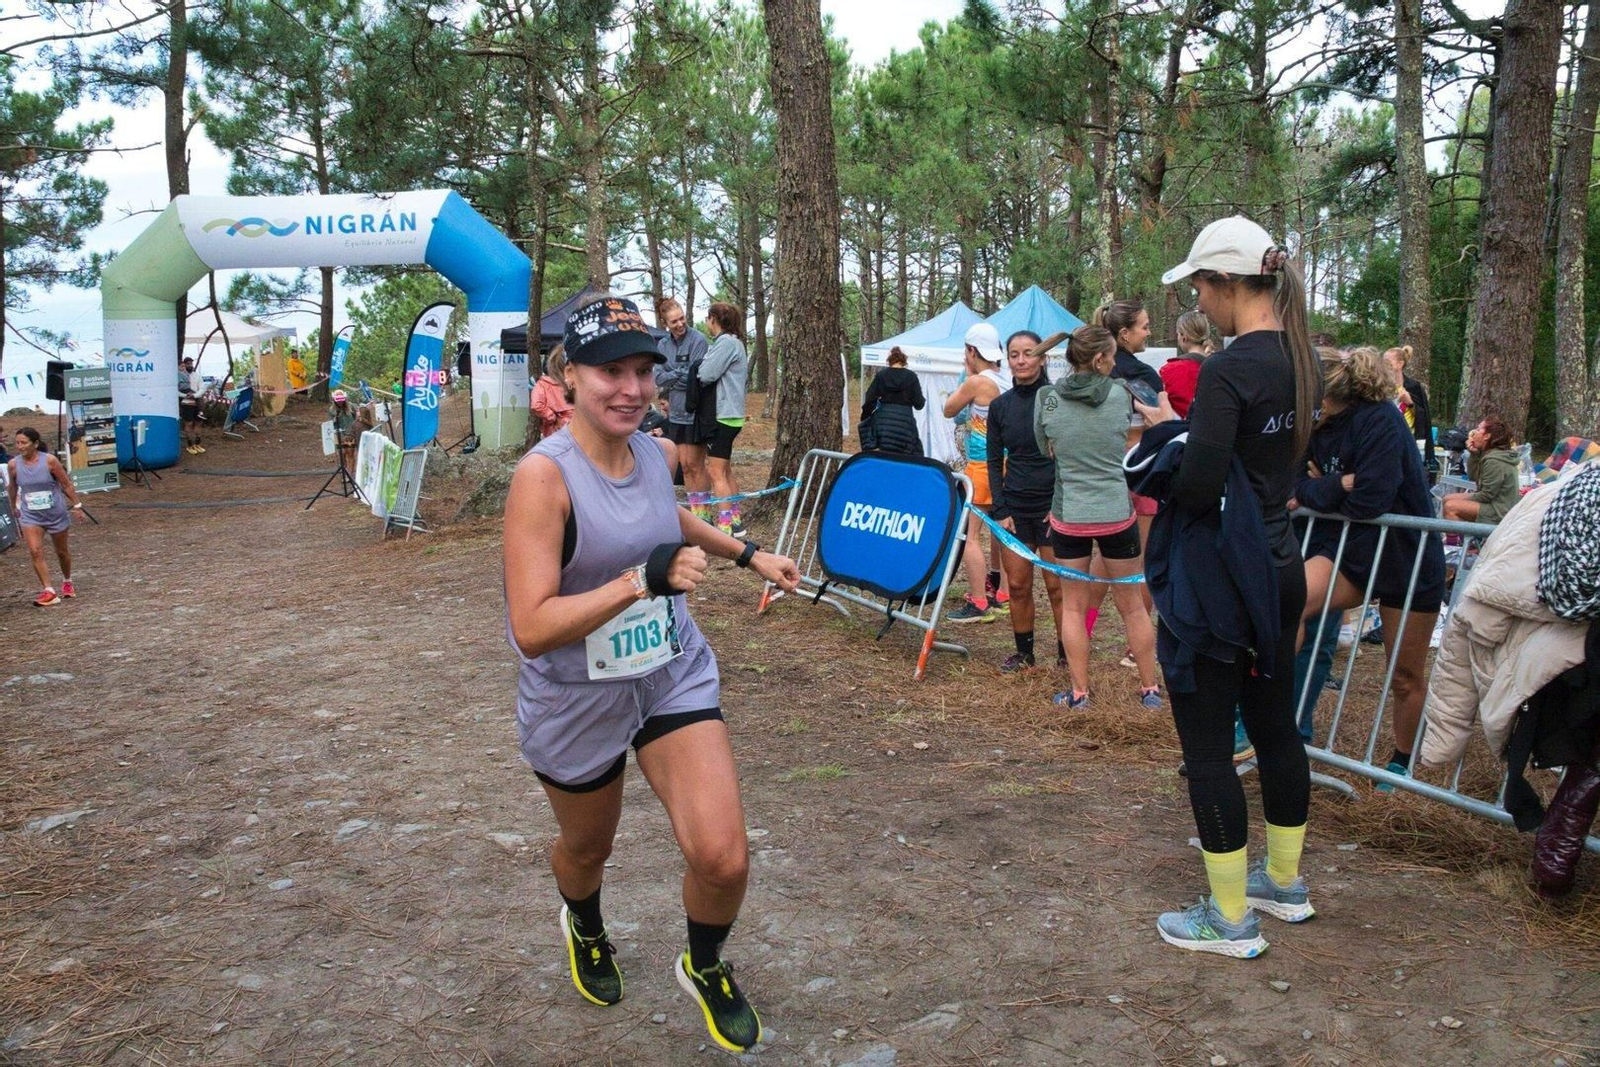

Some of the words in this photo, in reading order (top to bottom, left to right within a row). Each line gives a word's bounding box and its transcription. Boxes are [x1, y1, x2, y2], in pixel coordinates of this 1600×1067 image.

[306, 209, 417, 235] NIGRÁN
[840, 501, 926, 544] DECATHLON
[608, 619, 662, 659] 1703
